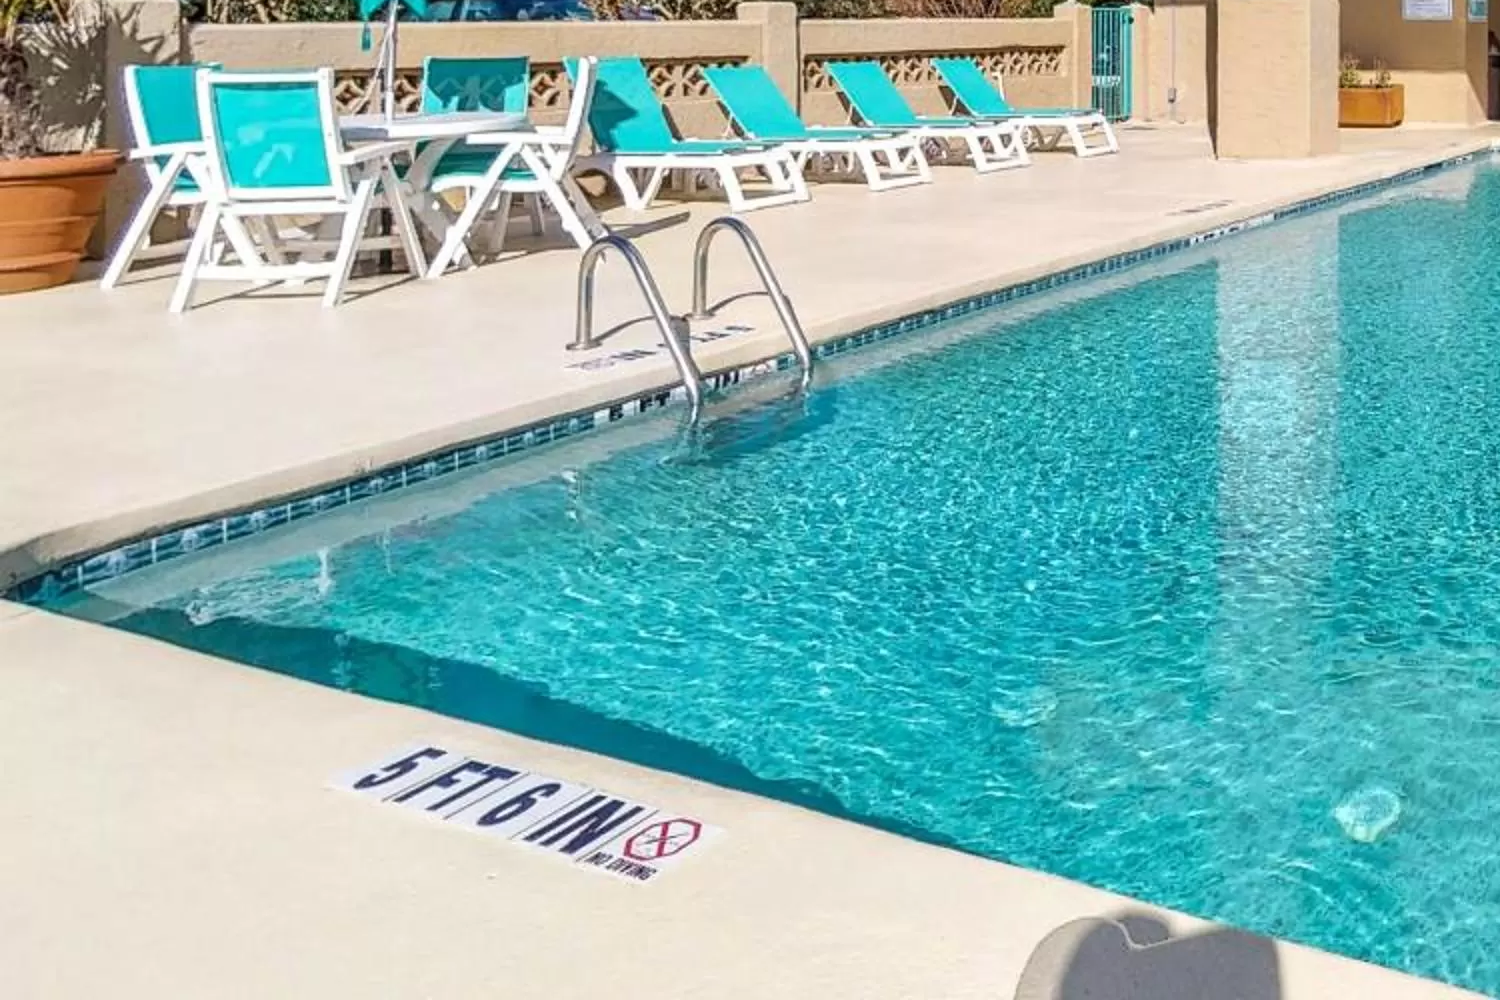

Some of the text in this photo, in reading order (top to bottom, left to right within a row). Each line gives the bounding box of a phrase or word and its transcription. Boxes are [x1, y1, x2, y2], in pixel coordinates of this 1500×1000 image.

[353, 747, 647, 854] 5 FT 6 IN
